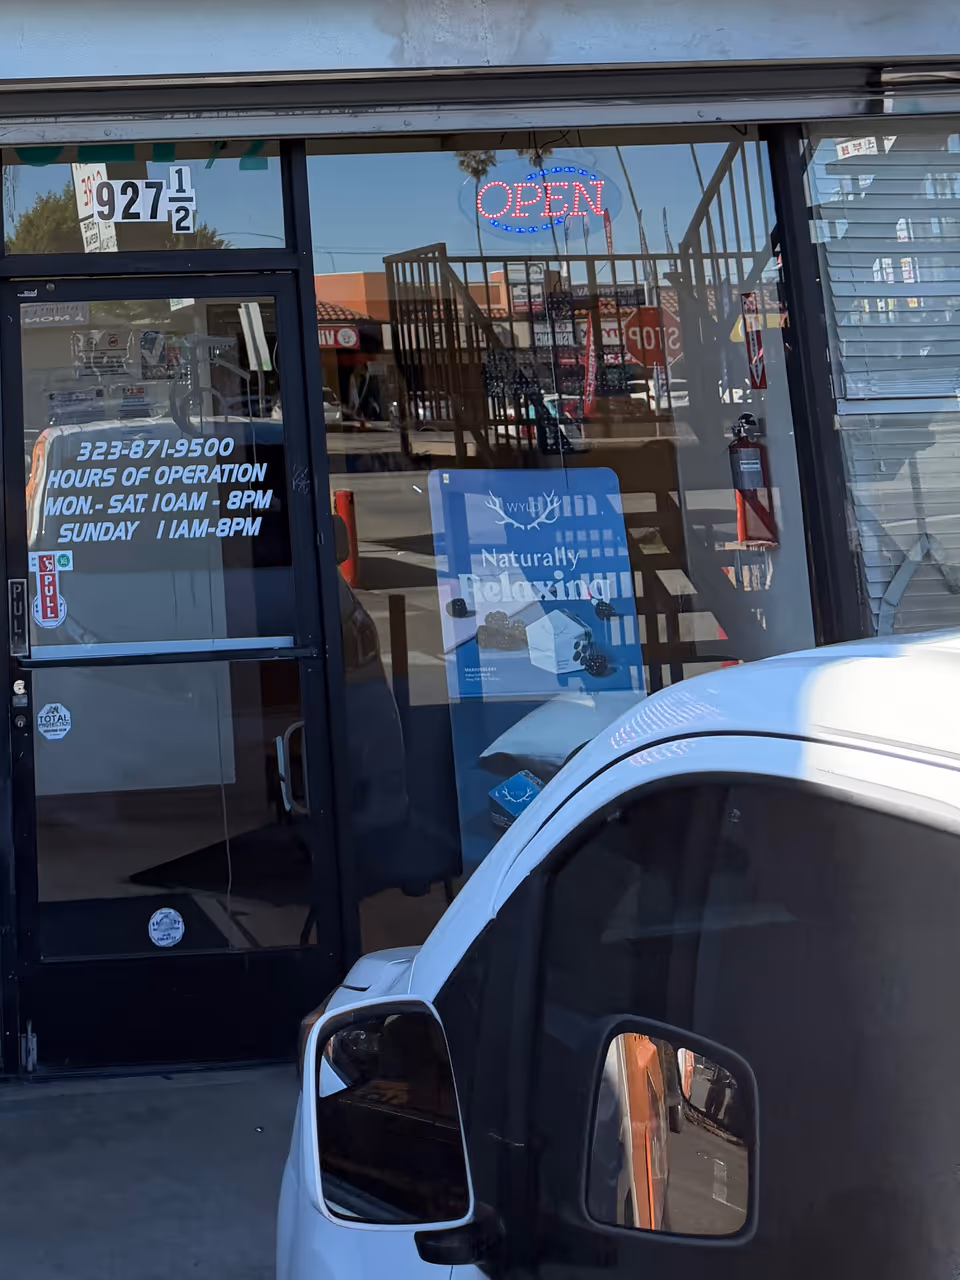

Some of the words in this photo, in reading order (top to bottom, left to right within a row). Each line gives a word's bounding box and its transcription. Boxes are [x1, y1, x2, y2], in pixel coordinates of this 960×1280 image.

[96, 180, 164, 221] 927
[476, 179, 606, 219] OPEN
[77, 437, 235, 461] 323-871-9500
[46, 467, 117, 489] HOURS
[121, 466, 151, 486] OF
[154, 462, 267, 485] OPERATION
[107, 493, 146, 514] SAT.
[152, 491, 208, 513] 10AM
[226, 489, 273, 510] 8PM
[506, 502, 541, 512] WYLD
[57, 521, 140, 543] SUNDAY
[480, 546, 581, 572] Naturally
[44, 575, 55, 618] PULL
[457, 570, 613, 606] Relaxing
